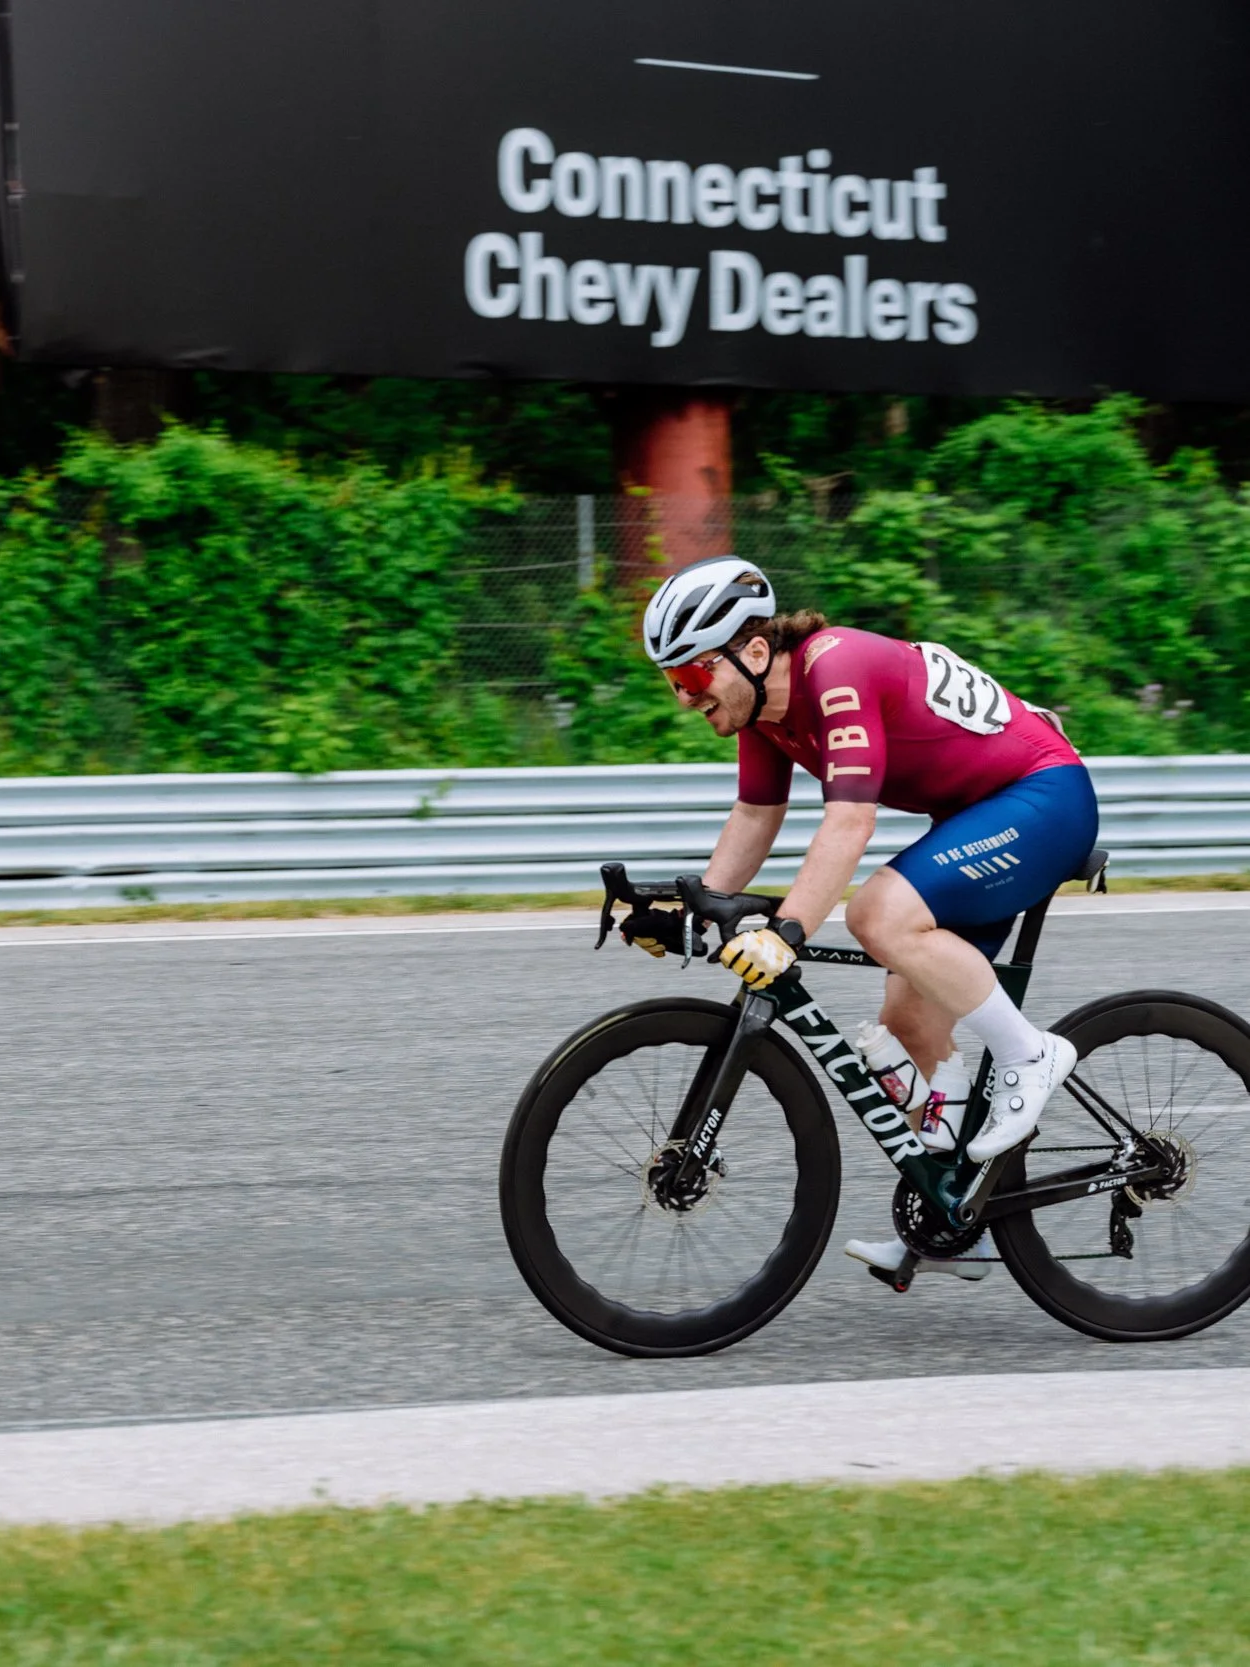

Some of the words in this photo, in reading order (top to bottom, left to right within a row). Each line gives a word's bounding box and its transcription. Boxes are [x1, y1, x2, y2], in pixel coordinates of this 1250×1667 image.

[498, 127, 947, 242] Connecticut
[464, 231, 699, 347] Chevy
[709, 250, 979, 344] Dealers
[931, 652, 1002, 727] 232
[819, 686, 871, 782] TBD
[932, 852, 950, 866] TO
[947, 847, 964, 861] BE
[961, 827, 1019, 857] DETERMINED
[784, 1000, 926, 1164] FACTOR
[692, 1108, 722, 1159] FACTOR
[1099, 1176, 1127, 1189] FACTOR
